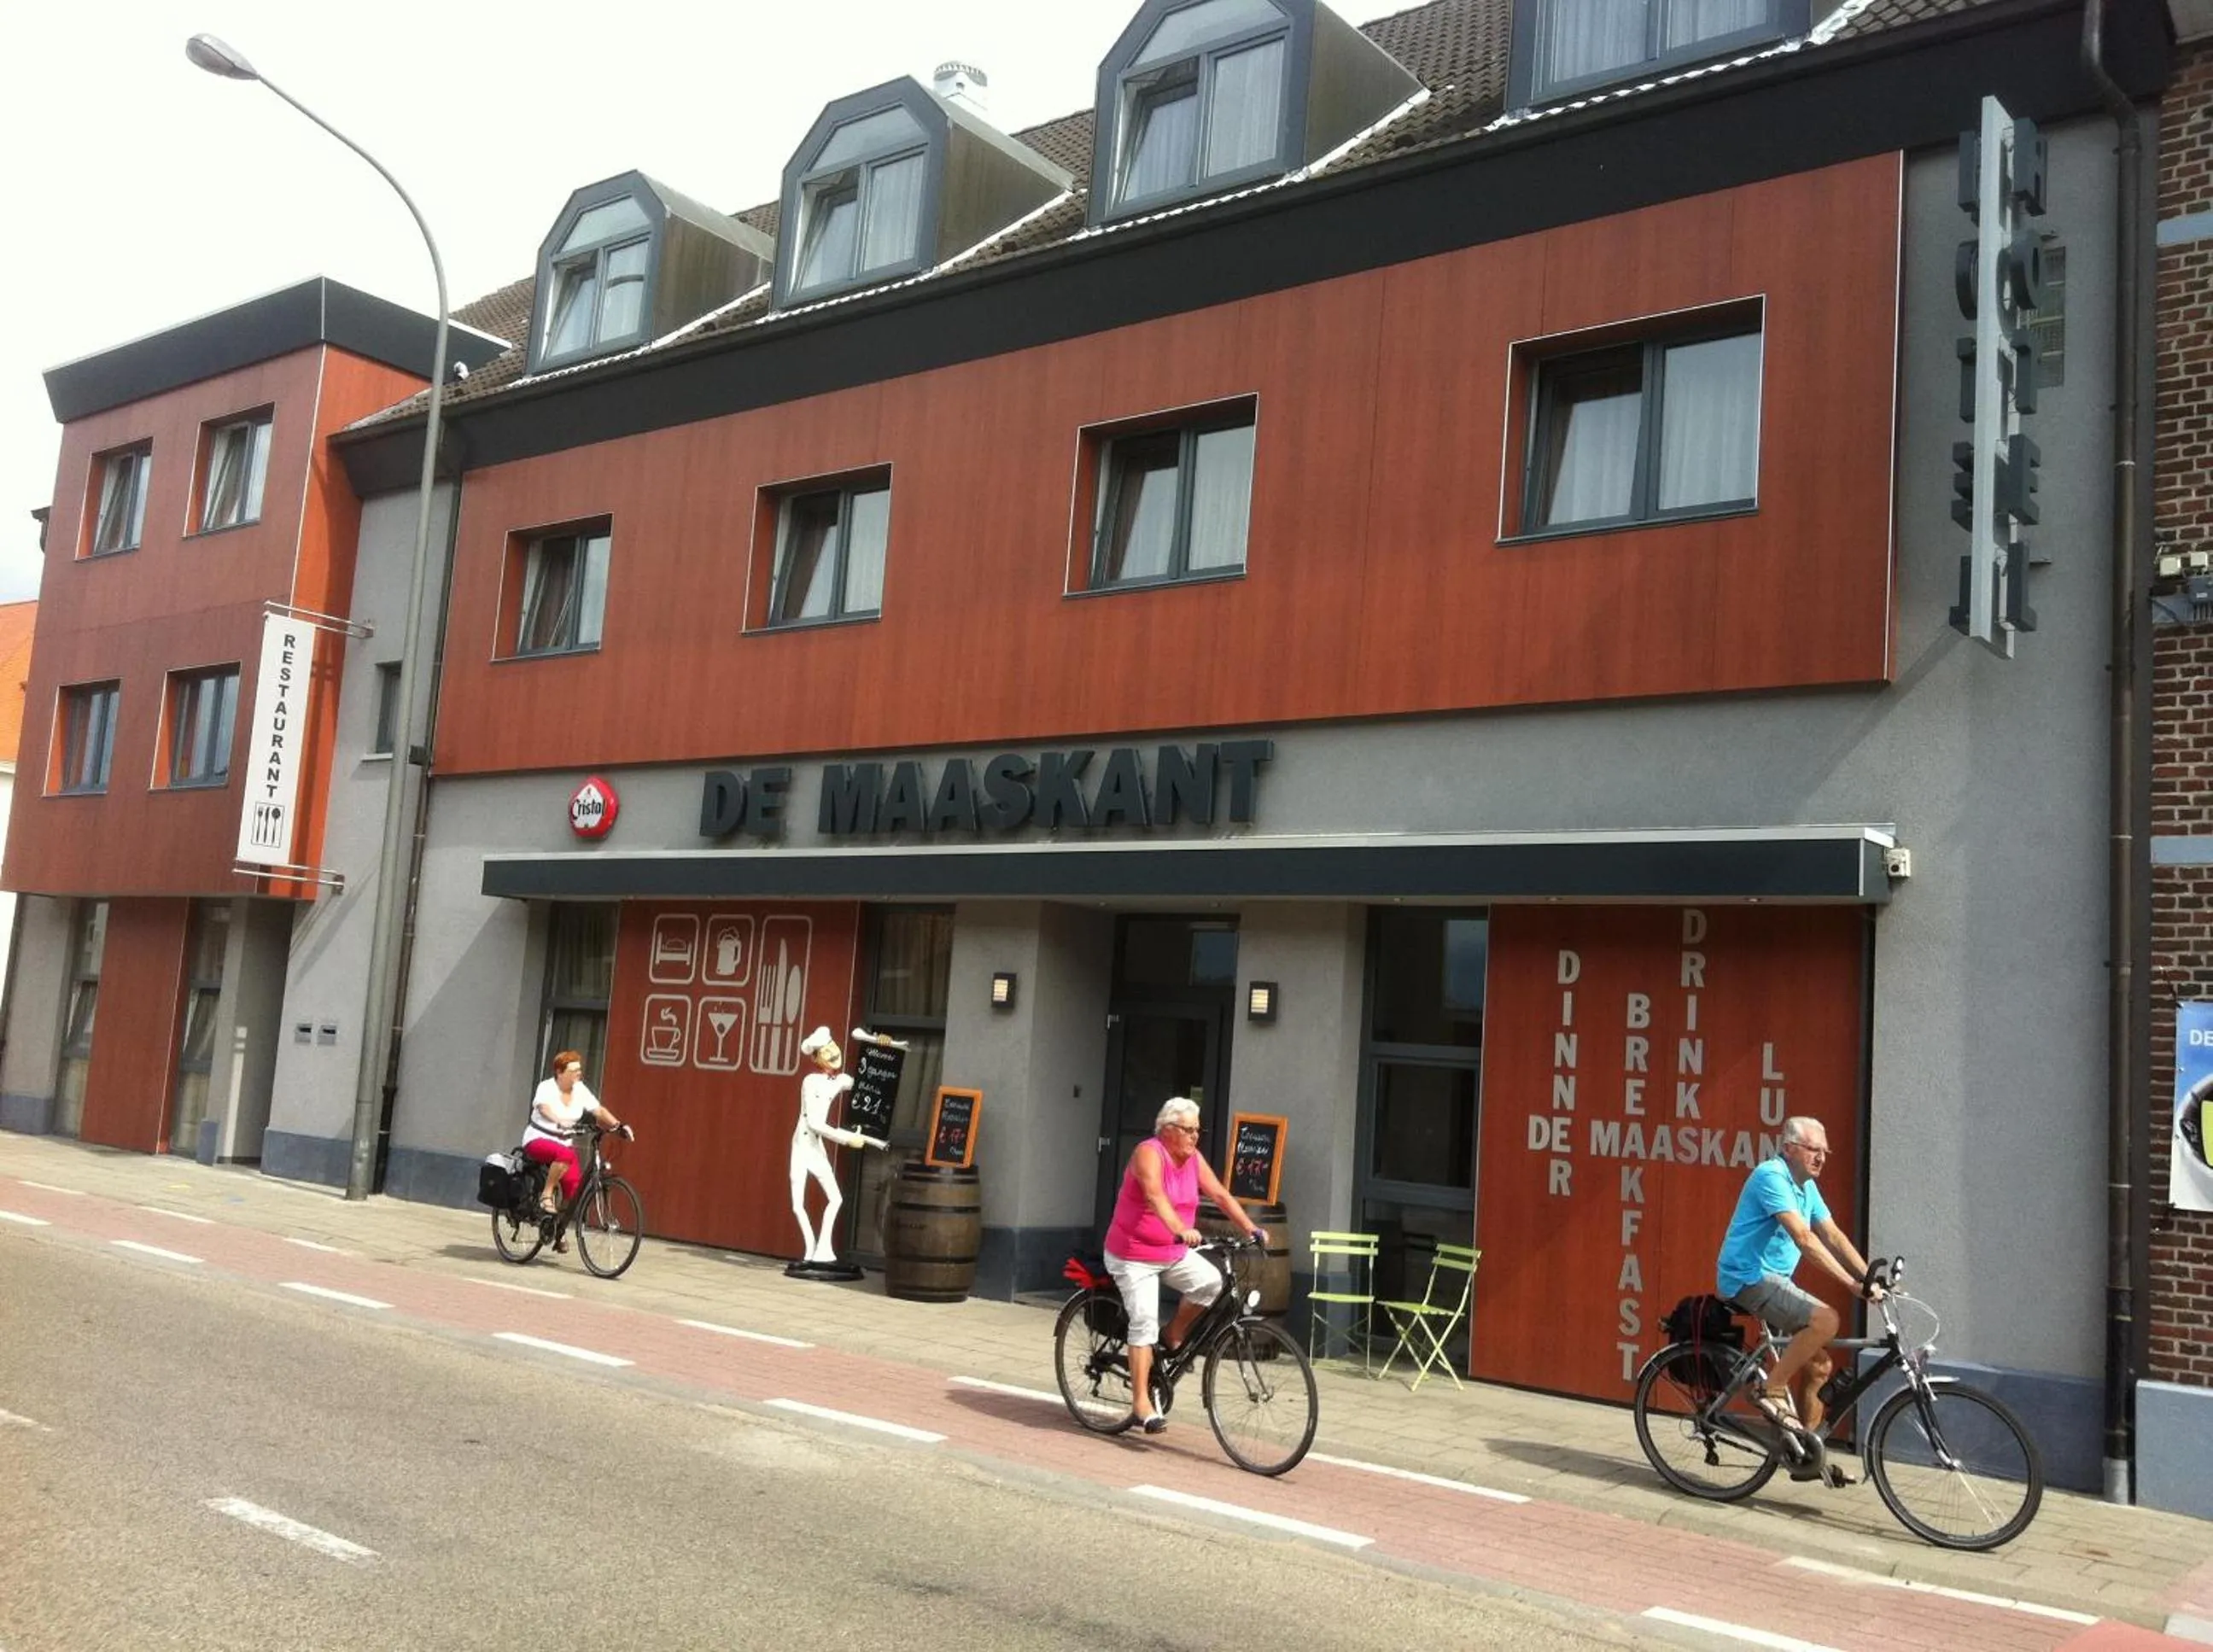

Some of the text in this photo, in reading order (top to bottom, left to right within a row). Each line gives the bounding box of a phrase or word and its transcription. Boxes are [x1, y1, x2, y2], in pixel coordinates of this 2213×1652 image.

[266, 633, 296, 799] RESTAURANT
[570, 798, 606, 820] Cristal
[699, 740, 1273, 837] DE MAASKANT
[1548, 949, 1580, 1197] DINNER
[1528, 1114, 1783, 1169] DE MAASKAN
[1616, 993, 1650, 1382] BREAKFAST
